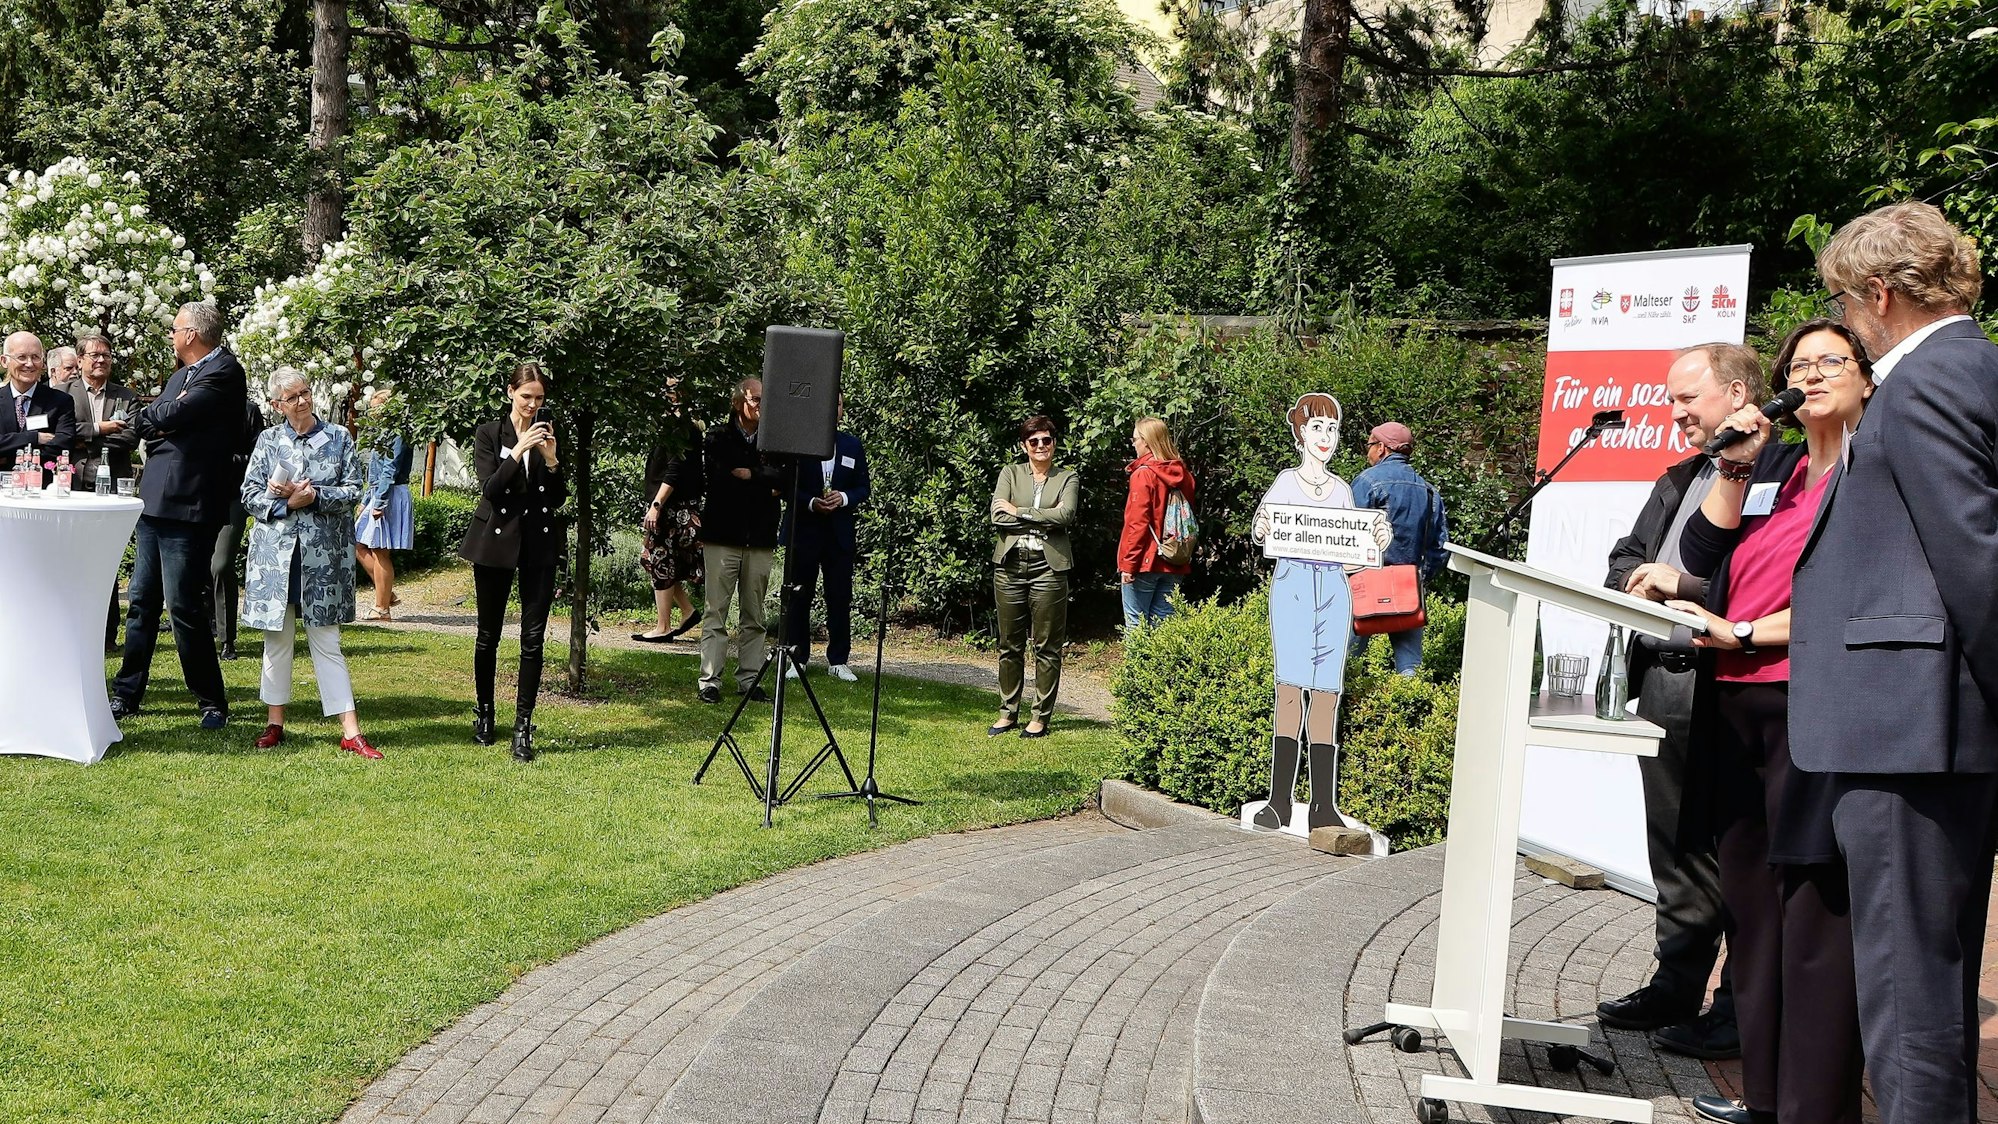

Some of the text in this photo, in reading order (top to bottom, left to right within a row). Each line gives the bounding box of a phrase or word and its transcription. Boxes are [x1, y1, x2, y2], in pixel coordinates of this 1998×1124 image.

[1633, 293, 1673, 308] Malteser
[1711, 298, 1737, 309] SKM
[1682, 314, 1697, 324] SkF
[1717, 309, 1736, 318] KÖLN
[1551, 375, 1589, 412] Für
[1592, 377, 1623, 408] ein
[1273, 511, 1372, 534] Für Klimaschutz,
[1273, 528, 1359, 548] der allen nutzt.
